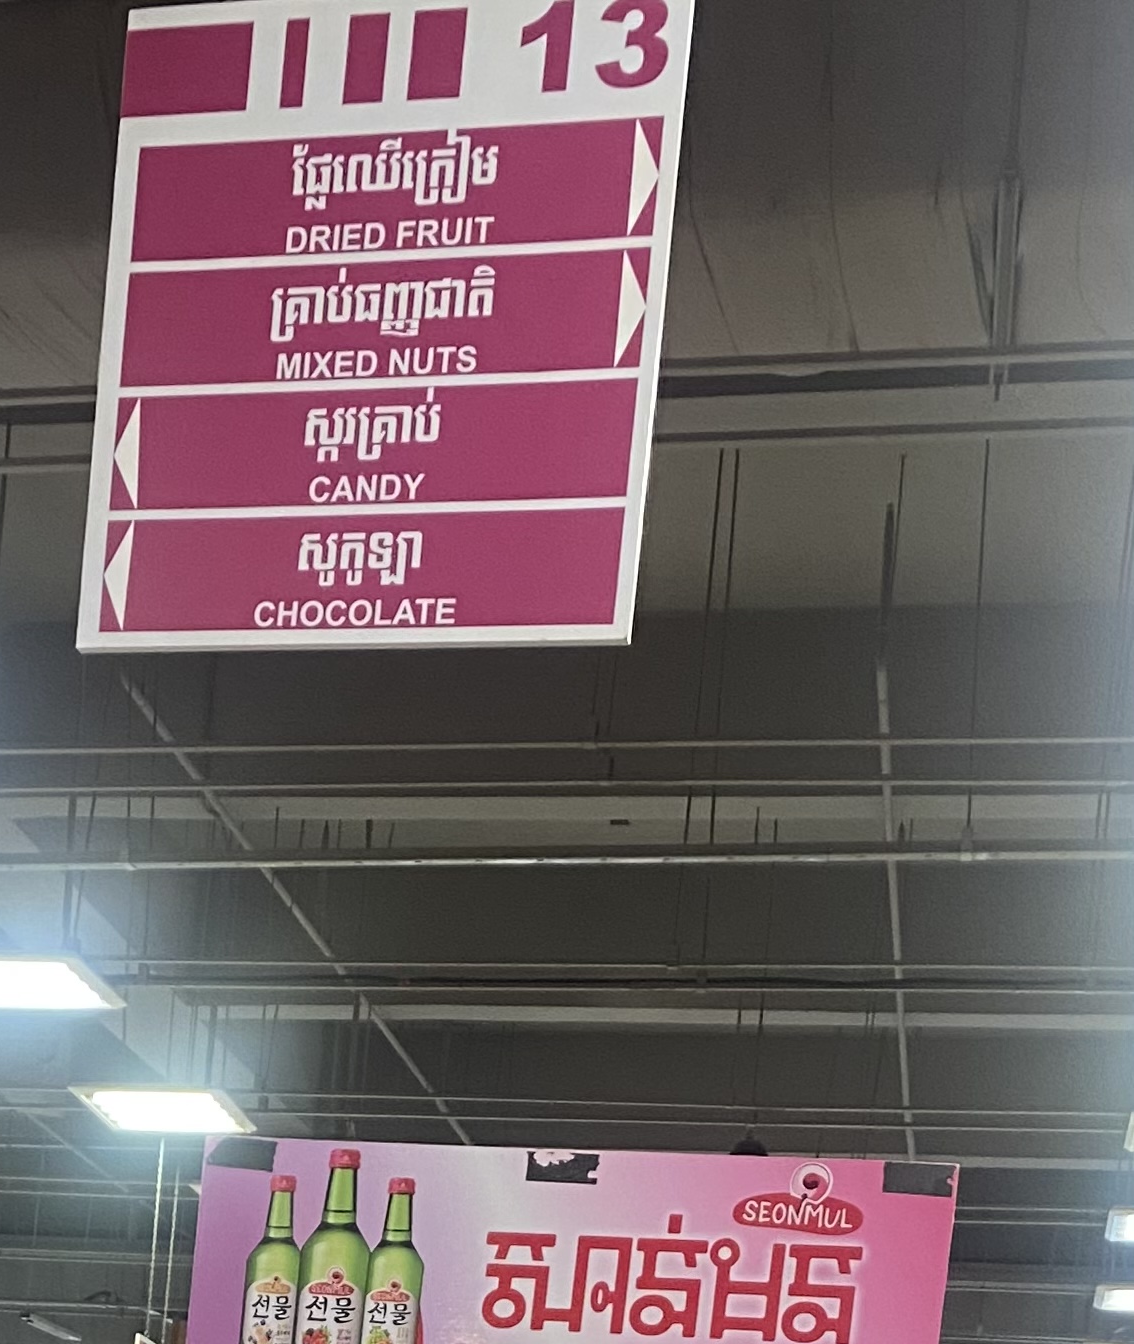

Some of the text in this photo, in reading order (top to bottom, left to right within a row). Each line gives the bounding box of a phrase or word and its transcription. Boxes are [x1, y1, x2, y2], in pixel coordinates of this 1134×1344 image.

[520, 0, 668, 93] 13
[285, 216, 495, 253] DRIED FRUIT
[275, 345, 478, 381] MIXED NUTS
[308, 473, 426, 503] CANDY
[253, 597, 458, 628] CHOCOLATE
[741, 1200, 853, 1229] SEONMUL
[251, 1294, 292, 1321] 선물
[305, 1296, 356, 1323] 선물
[367, 1302, 411, 1326] 선물
